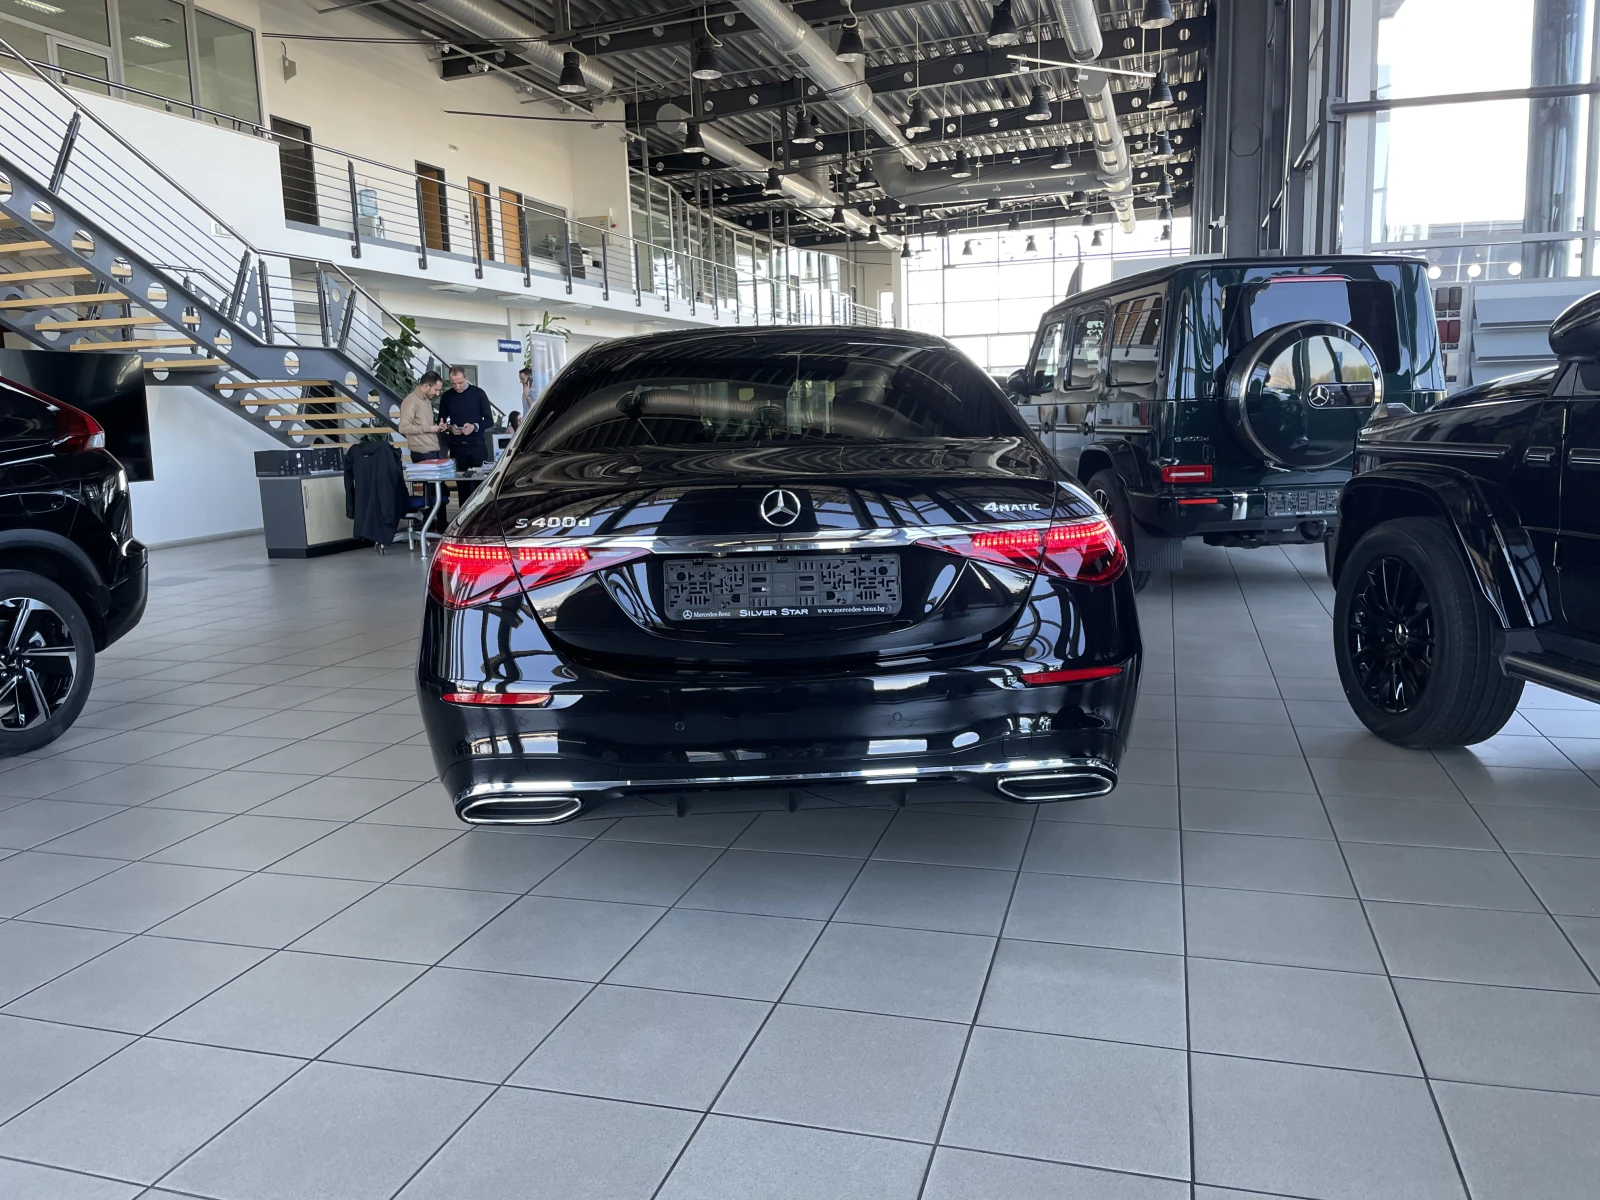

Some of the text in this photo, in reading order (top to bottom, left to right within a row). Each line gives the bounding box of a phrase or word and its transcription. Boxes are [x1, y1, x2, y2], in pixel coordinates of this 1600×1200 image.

[983, 502, 1041, 512] 4MATIC
[514, 516, 591, 529] S 400d
[739, 608, 809, 617] SILVER STAR
[817, 605, 885, 614] www.mercedes-benz.bg
